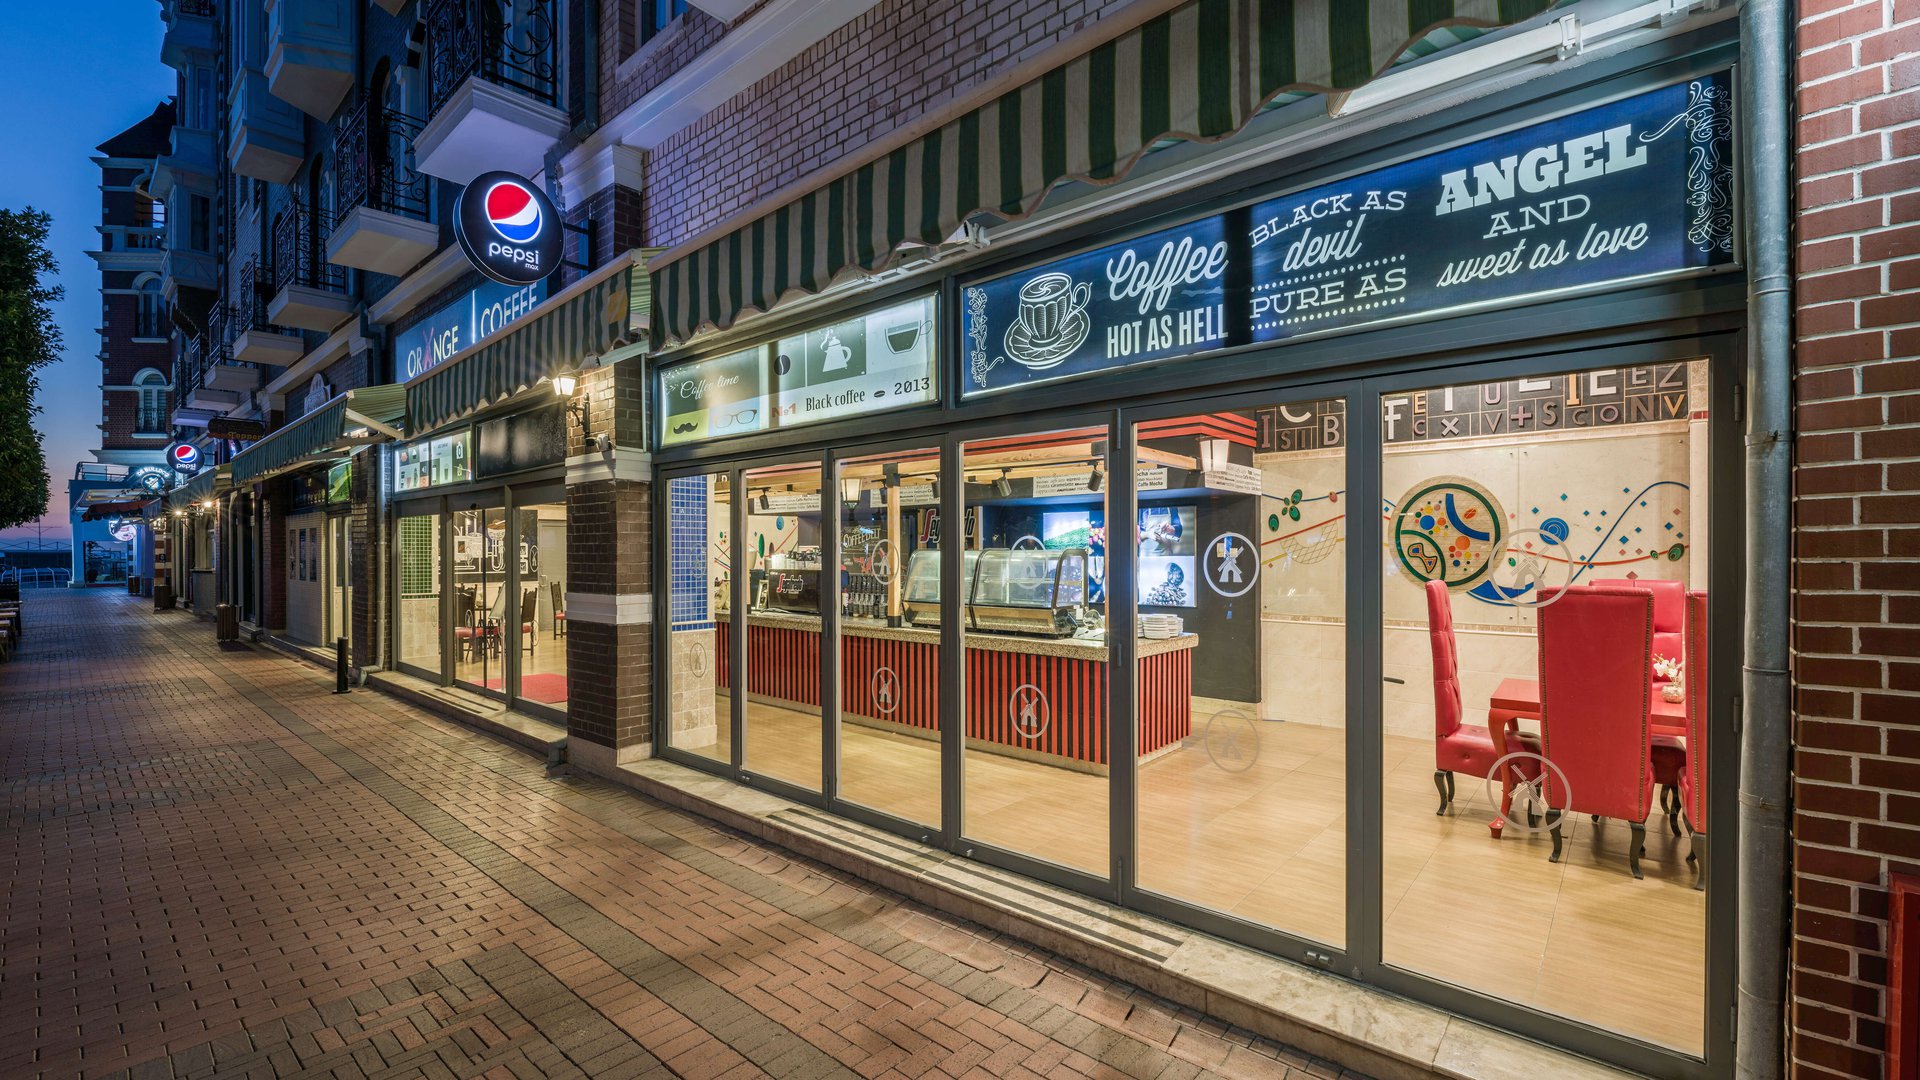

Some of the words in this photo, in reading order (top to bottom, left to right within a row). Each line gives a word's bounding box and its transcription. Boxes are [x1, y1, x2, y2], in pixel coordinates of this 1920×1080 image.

[1435, 123, 1648, 217] ANGEL
[1249, 193, 1352, 249] BLACK
[1364, 190, 1407, 212] AS
[1282, 213, 1367, 273] devil
[1482, 193, 1591, 240] AND
[488, 241, 539, 264] pepsi
[525, 263, 539, 271] max
[1106, 236, 1229, 315] Coffee
[1436, 234, 1526, 289] sweet
[1529, 239, 1570, 270] as
[1578, 221, 1649, 258] love
[480, 281, 537, 339] COFFEE
[1249, 281, 1345, 319] PURE
[1353, 267, 1407, 298] AS
[1107, 323, 1141, 359] HOT
[1147, 317, 1173, 352] AS
[1179, 304, 1229, 346] HELL
[680, 379, 714, 400] Coffee
[806, 396, 833, 412] Black
[834, 389, 866, 407] coffee
[894, 377, 930, 396] 2013
